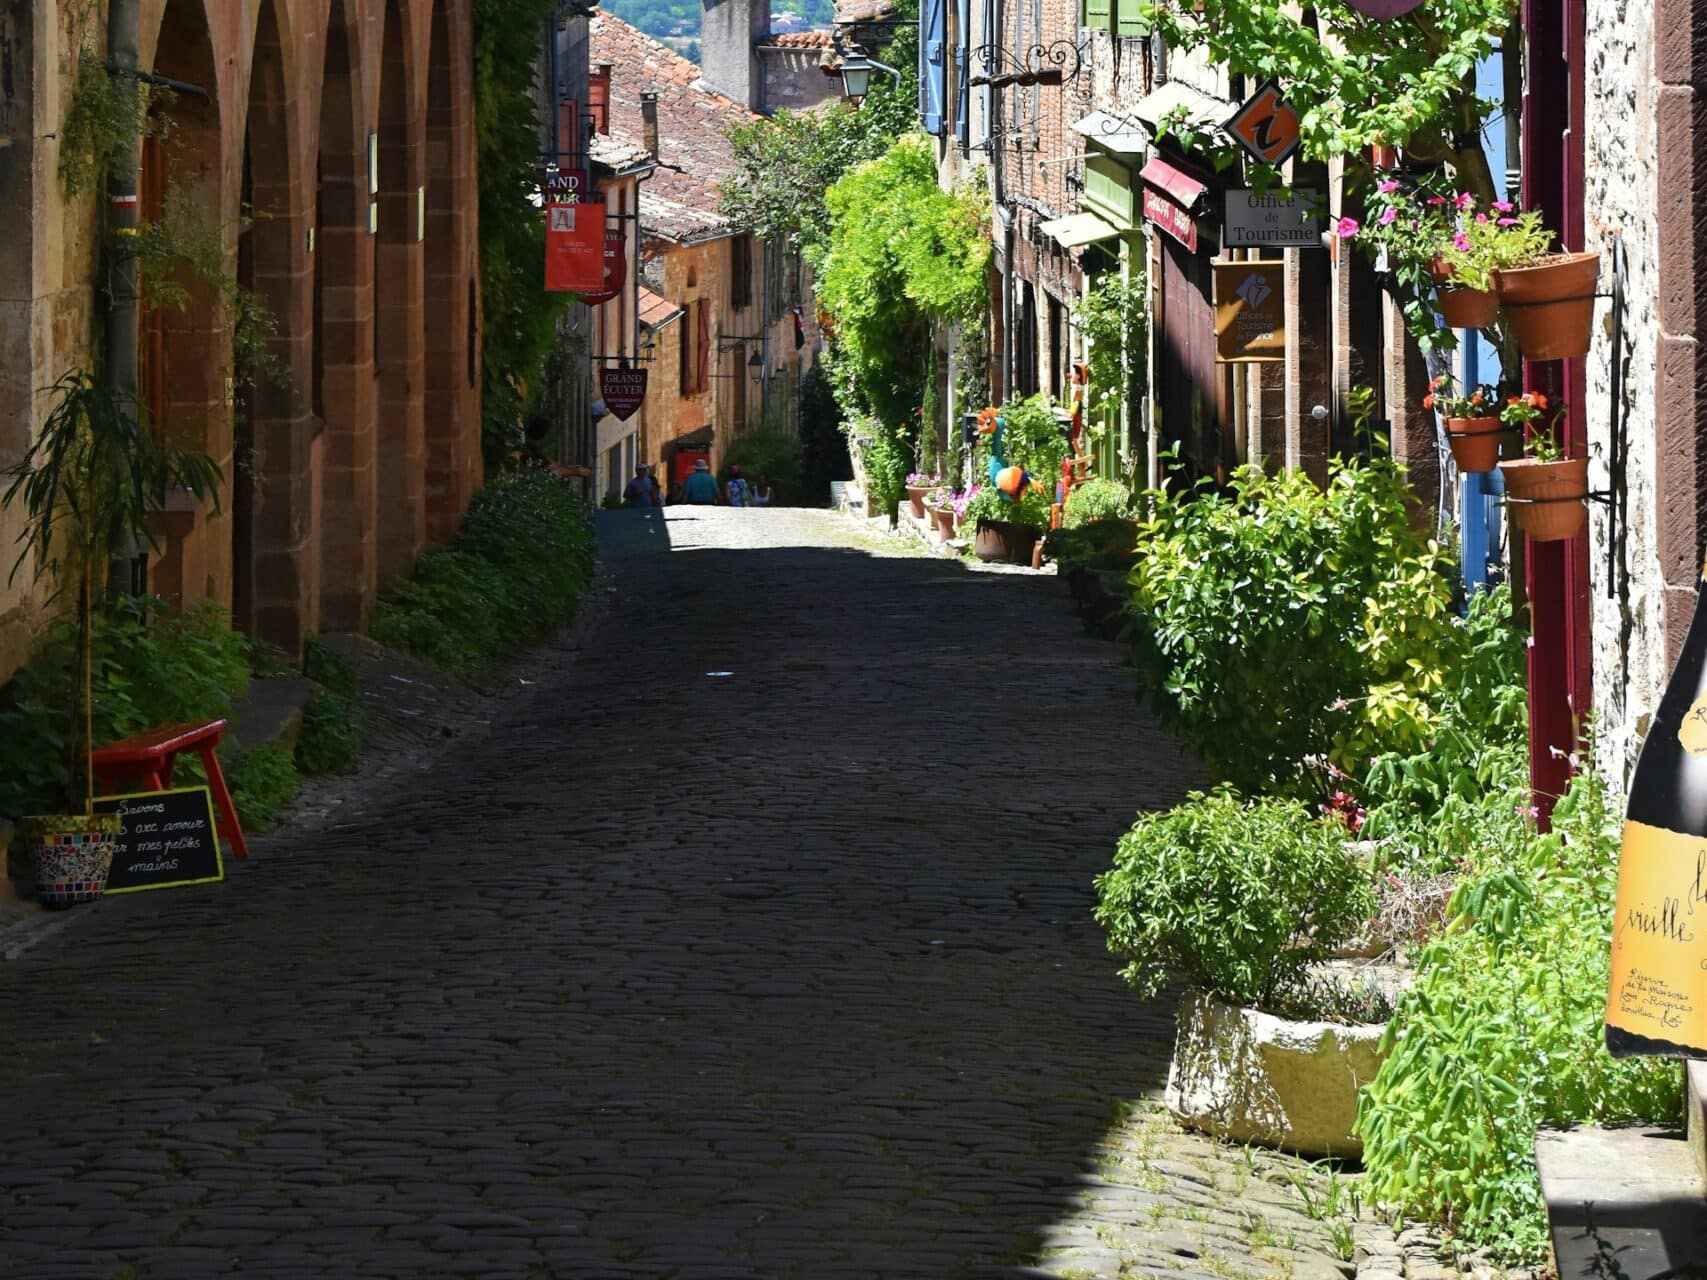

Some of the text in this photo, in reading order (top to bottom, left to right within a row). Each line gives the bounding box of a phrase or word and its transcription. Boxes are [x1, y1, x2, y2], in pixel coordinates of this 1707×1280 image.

[1264, 212, 1279, 223] de
[1233, 226, 1313, 241] Tourisme
[605, 374, 642, 383] GRAND
[116, 800, 165, 815] Savons
[137, 841, 162, 852] mes
[128, 856, 180, 872] mains
[1617, 896, 1694, 949] vieille
